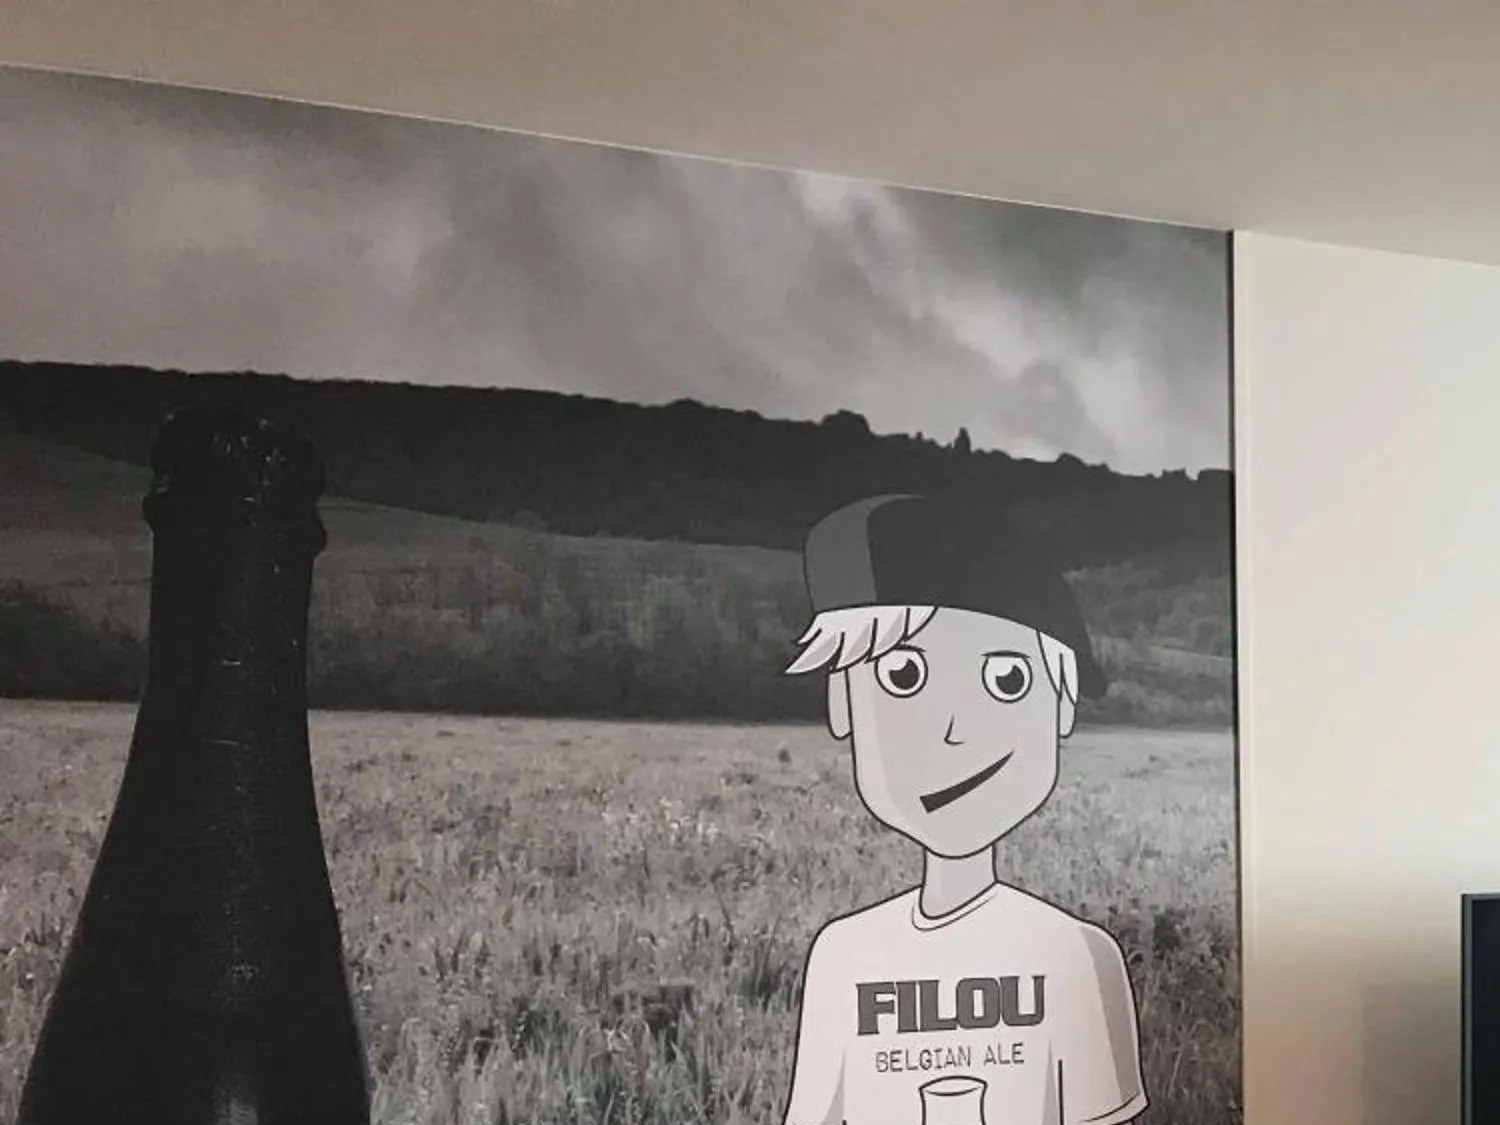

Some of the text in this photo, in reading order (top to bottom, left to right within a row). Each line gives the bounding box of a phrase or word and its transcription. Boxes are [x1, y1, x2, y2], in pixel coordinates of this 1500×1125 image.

[856, 974, 1046, 1036] FILOU
[874, 1041, 1025, 1073] BELGIAN ALE
